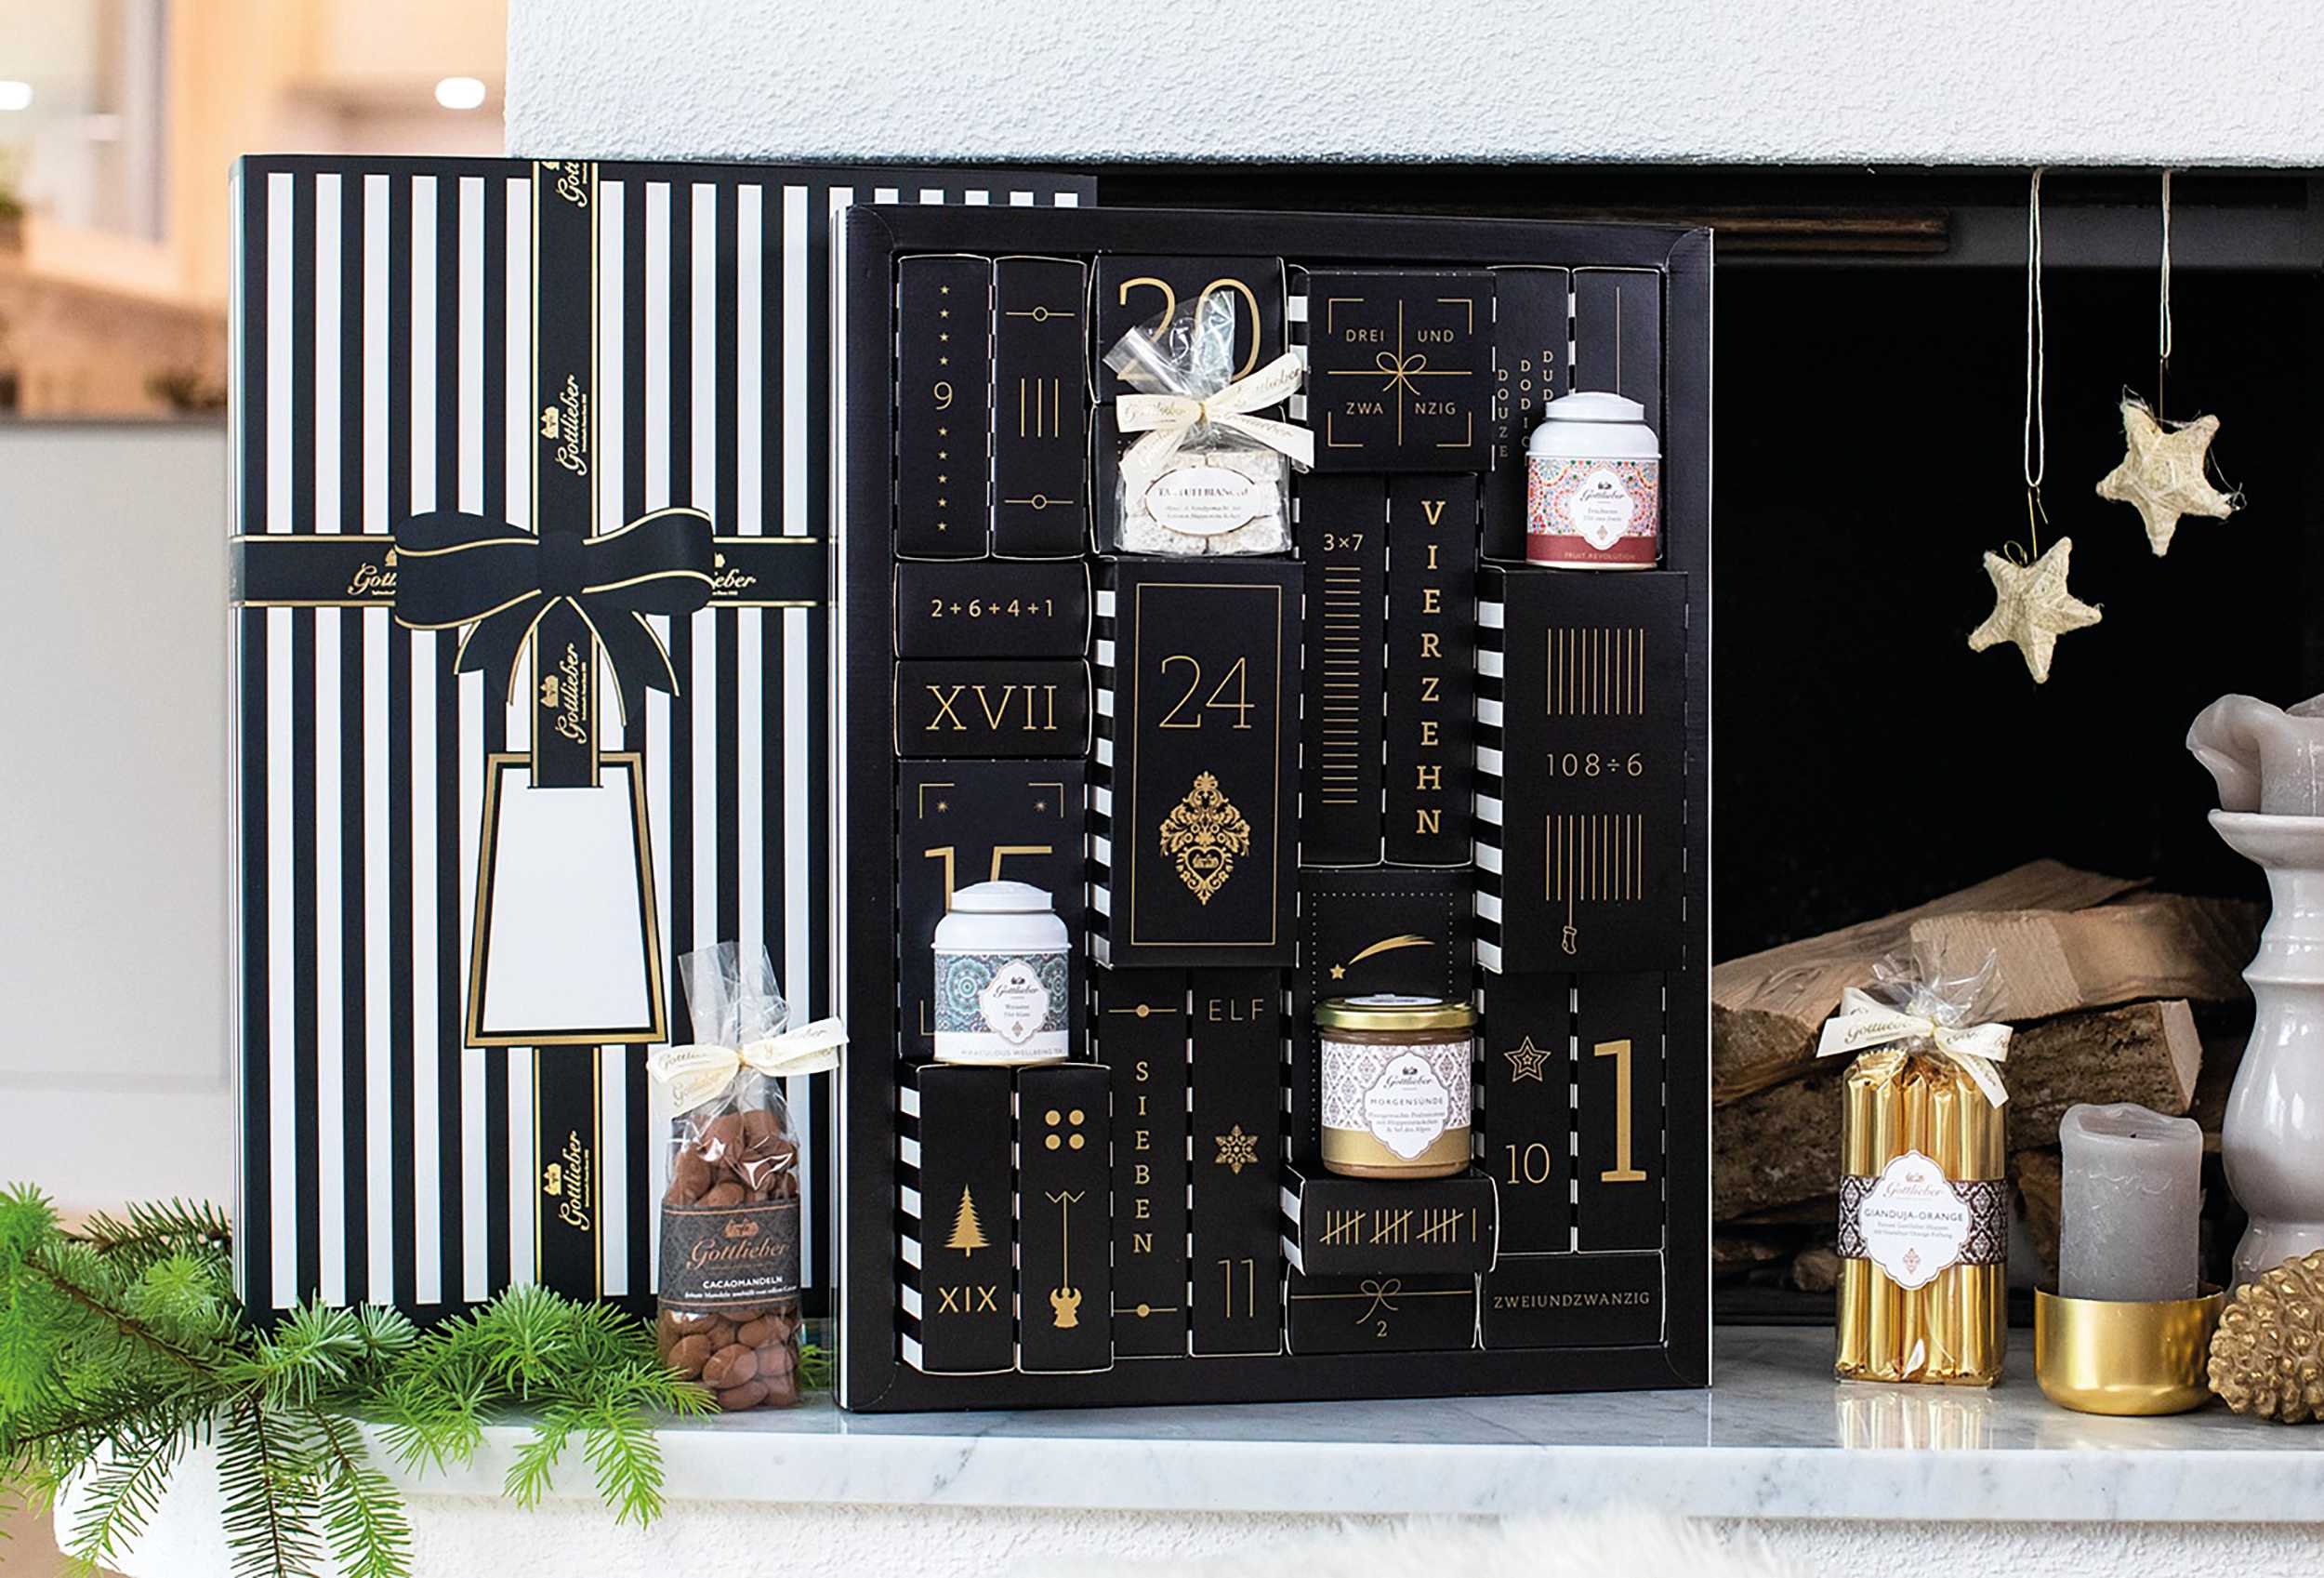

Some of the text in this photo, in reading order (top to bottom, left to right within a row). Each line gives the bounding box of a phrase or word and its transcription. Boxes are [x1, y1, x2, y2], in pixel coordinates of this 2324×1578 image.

[1117, 278, 1261, 381] 20
[1346, 328, 1454, 343] DREI UND
[933, 381, 953, 410] 9
[1346, 402, 1456, 415] ZWA NZIG
[1498, 369, 1509, 457] DOUZE
[555, 374, 588, 475] Gottlieber
[1416, 500, 1446, 834] VIERZEHN
[555, 643, 588, 744] Gottlieber
[926, 684, 1057, 730] XVII
[1159, 655, 1255, 729] 24
[1547, 752, 1643, 776] 108÷6
[1208, 999, 1264, 1021] ELF
[1594, 1040, 1646, 1181] 1
[1133, 1061, 1153, 1253] SIEBEN
[1505, 1143, 1550, 1184] 10
[558, 1130, 590, 1230] Gottlieber
[686, 1236, 788, 1270] Gottlieber
[703, 1275, 783, 1289] CACAOMANDELN
[938, 1285, 997, 1314] XIX
[1218, 1258, 1254, 1319] 11
[1494, 1292, 1649, 1308] ZWEIUNDZWANZIG
[1377, 1320, 1387, 1337] 2
